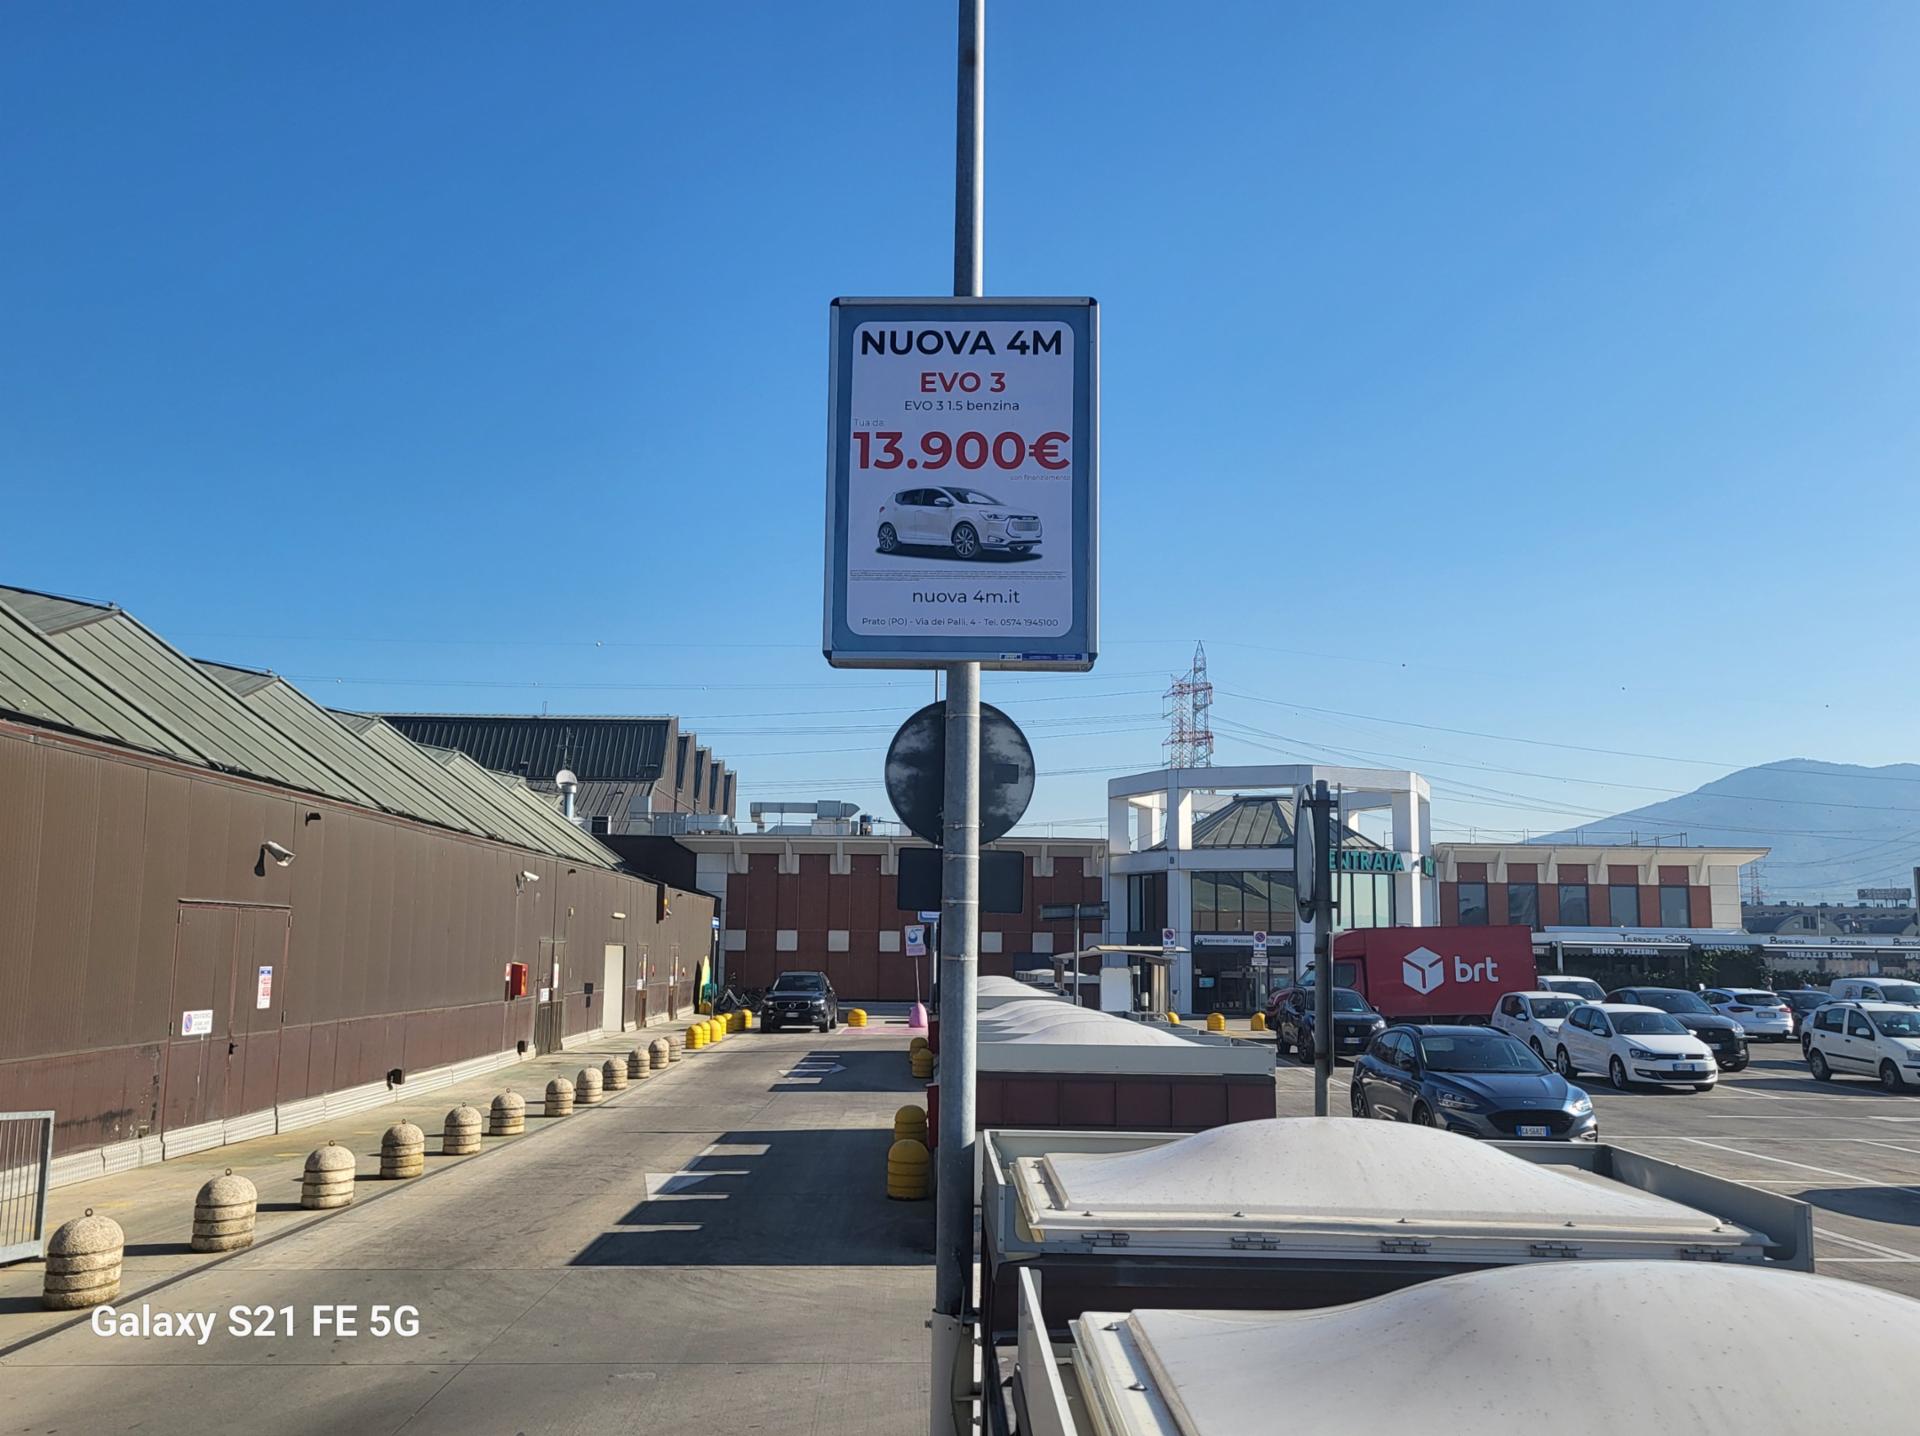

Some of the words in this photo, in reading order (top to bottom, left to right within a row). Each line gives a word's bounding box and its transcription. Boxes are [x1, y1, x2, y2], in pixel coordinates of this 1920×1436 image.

[861, 330, 996, 355] NUOVA
[1006, 330, 1062, 355] 4M
[920, 372, 982, 393] EVO
[990, 372, 1006, 393] 3
[904, 400, 934, 411] EVO
[936, 401, 944, 411] 3
[948, 401, 963, 411] 1.5
[966, 399, 1020, 411] benzina
[854, 418, 870, 427] Tua
[853, 431, 1071, 470] 13.900€
[912, 591, 967, 604] nuova
[973, 589, 1020, 604] 4m.it
[862, 617, 886, 625] Prato
[888, 617, 908, 627] (PO)
[915, 617, 929, 626] Via
[931, 617, 945, 626] dei
[1000, 618, 1021, 627] 0574
[1329, 849, 1405, 871] ENTRATA
[1454, 955, 1499, 983] brt
